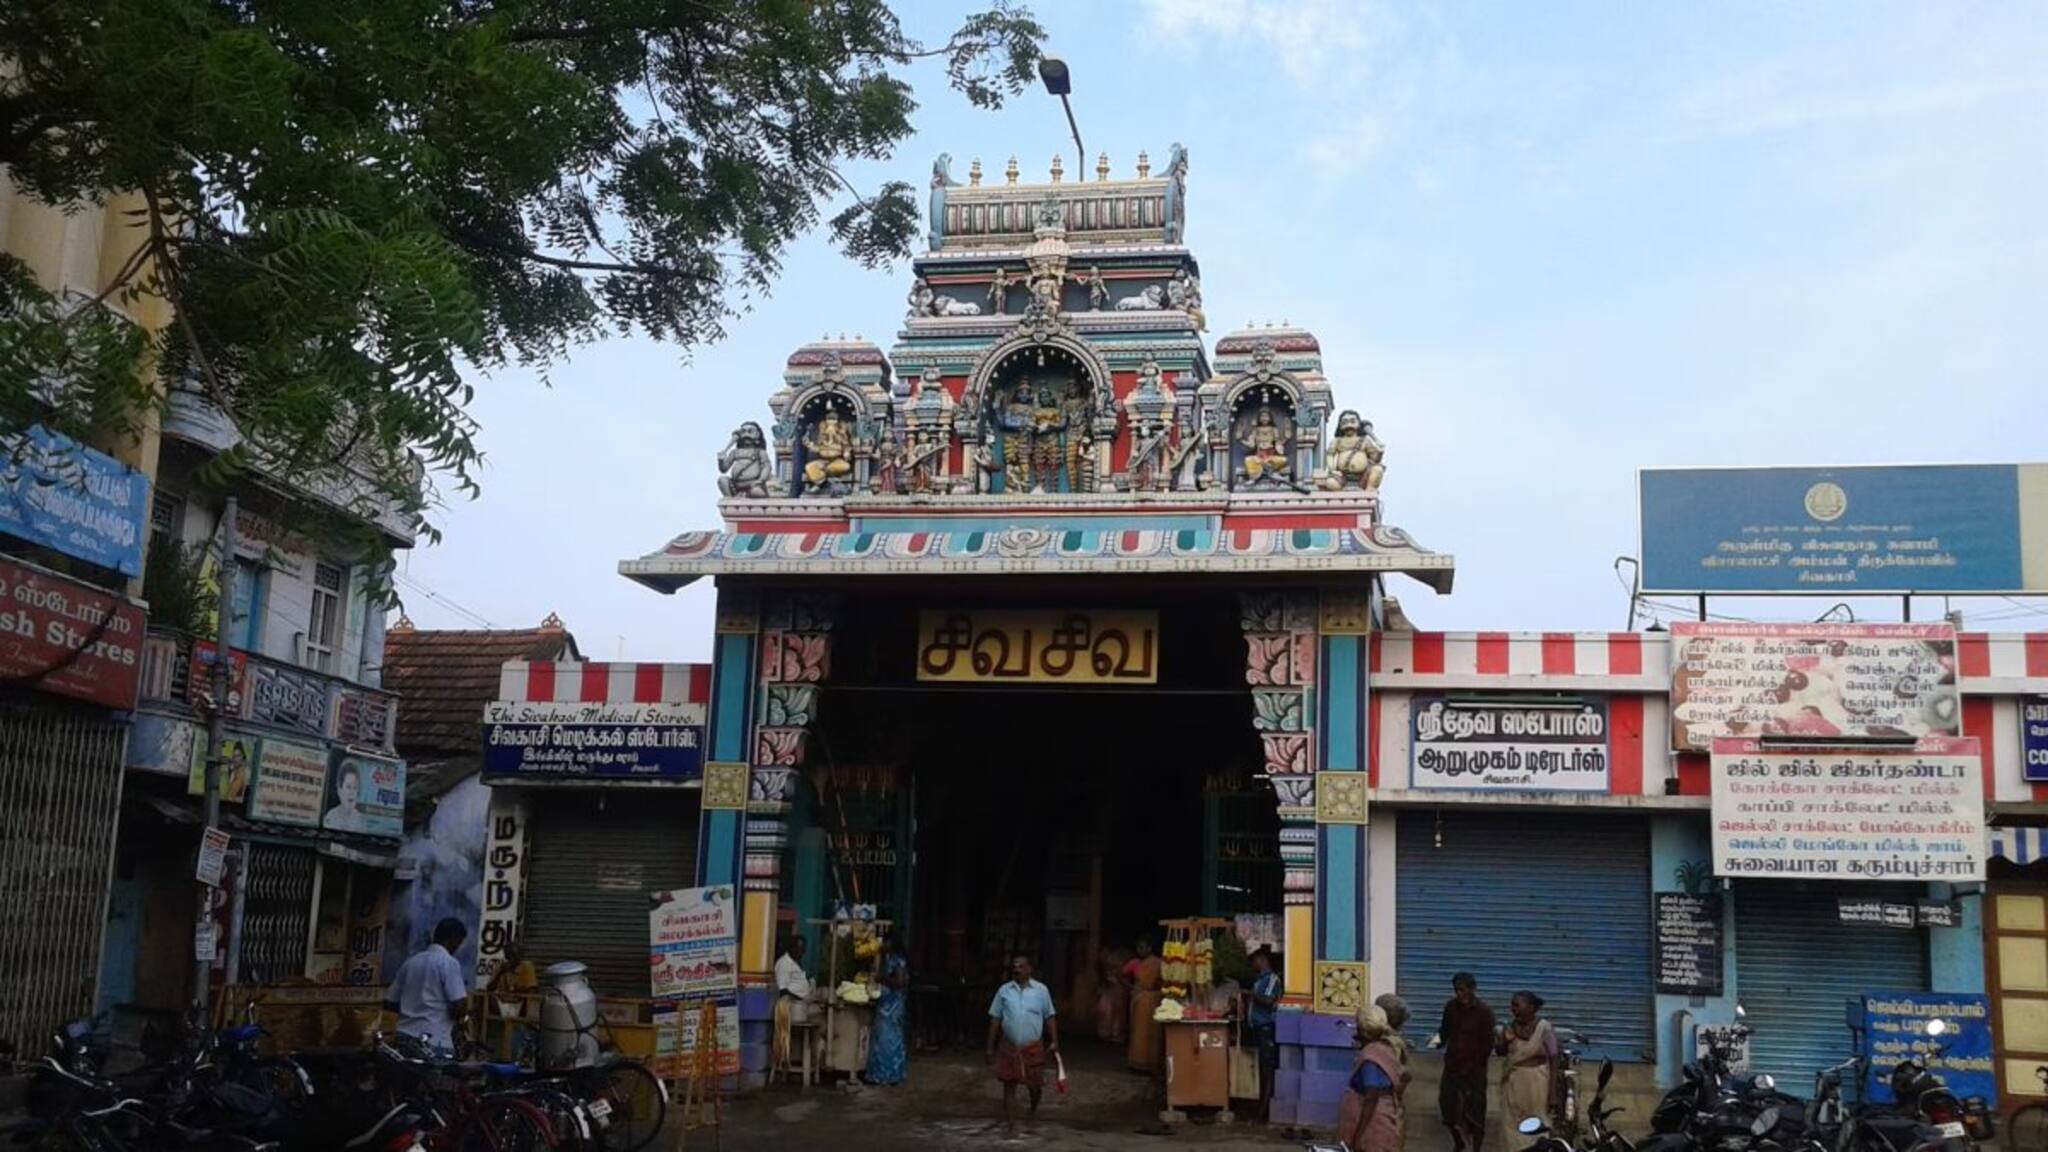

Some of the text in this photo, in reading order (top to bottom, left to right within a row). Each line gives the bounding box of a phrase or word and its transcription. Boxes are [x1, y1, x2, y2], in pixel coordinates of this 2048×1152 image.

[921, 614, 1154, 677] சிவ சிவ
[580, 707, 638, 724] Medical
[489, 725, 549, 747] சிவகாசி
[1418, 746, 1606, 777] ஆறுமுகம் டிரேடர்ஸ்
[1727, 758, 1966, 780] ஜில் ஜில் ஜிகர்தண்டா
[1724, 857, 1839, 874] சுவையான
